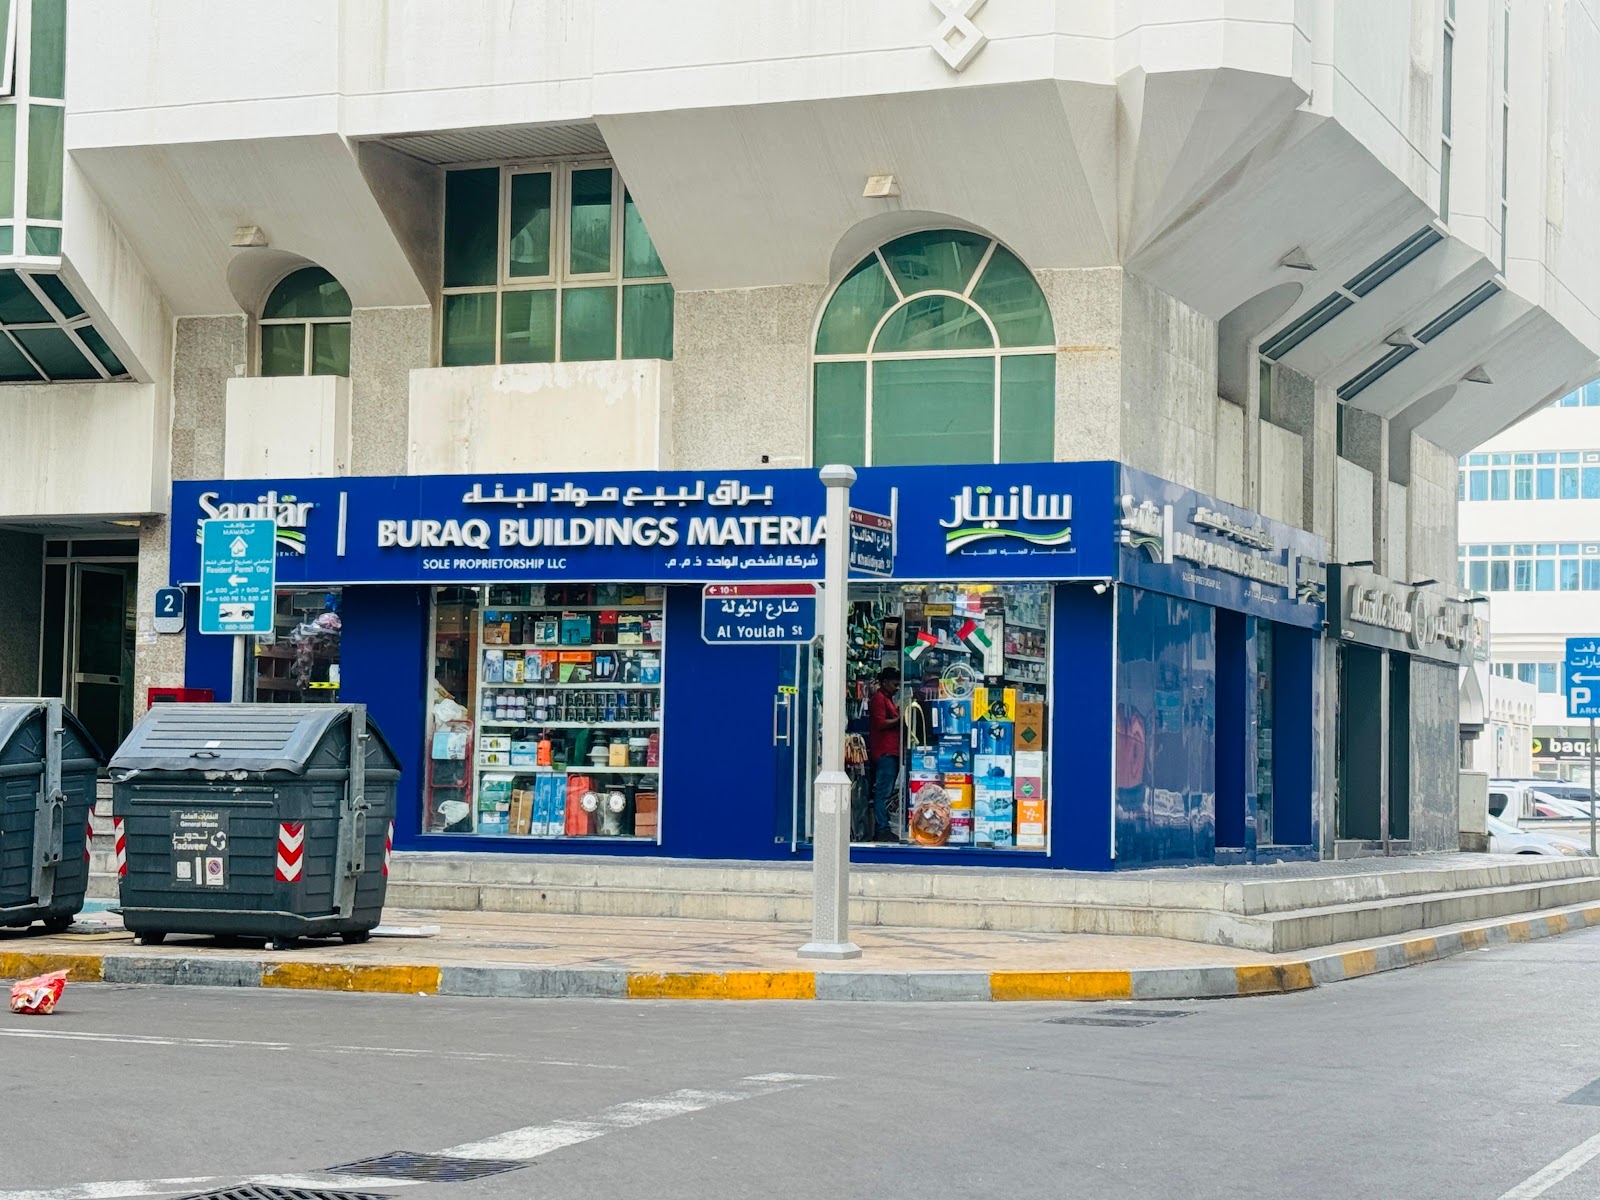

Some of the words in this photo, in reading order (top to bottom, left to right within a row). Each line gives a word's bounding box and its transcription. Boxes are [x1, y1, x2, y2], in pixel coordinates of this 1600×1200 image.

[462, 482, 547, 509] البناء
[551, 482, 619, 507] مواد
[623, 480, 704, 507] لبيع
[708, 480, 773, 506] براق
[939, 485, 1072, 528] سانيتار
[377, 518, 491, 550] BURAQ
[499, 515, 680, 547] BUILDINGS
[686, 515, 827, 546] MATERIA
[423, 559, 450, 570] SOLE
[453, 558, 545, 570] PROPRIETORSHIP
[548, 558, 567, 569] LLC
[706, 555, 739, 569] الواحد
[740, 553, 784, 569] الشخص
[785, 553, 819, 569] شركة
[206, 566, 232, 574] Resident
[256, 565, 270, 575] Only
[720, 586, 738, 594] 10-1
[164, 594, 174, 612] 2
[765, 599, 800, 620] شارع
[717, 625, 731, 638] Al
[737, 625, 785, 638] Youlah
[791, 625, 803, 636] St
[172, 831, 208, 842] تدوير
[172, 841, 208, 850] Tadweer
